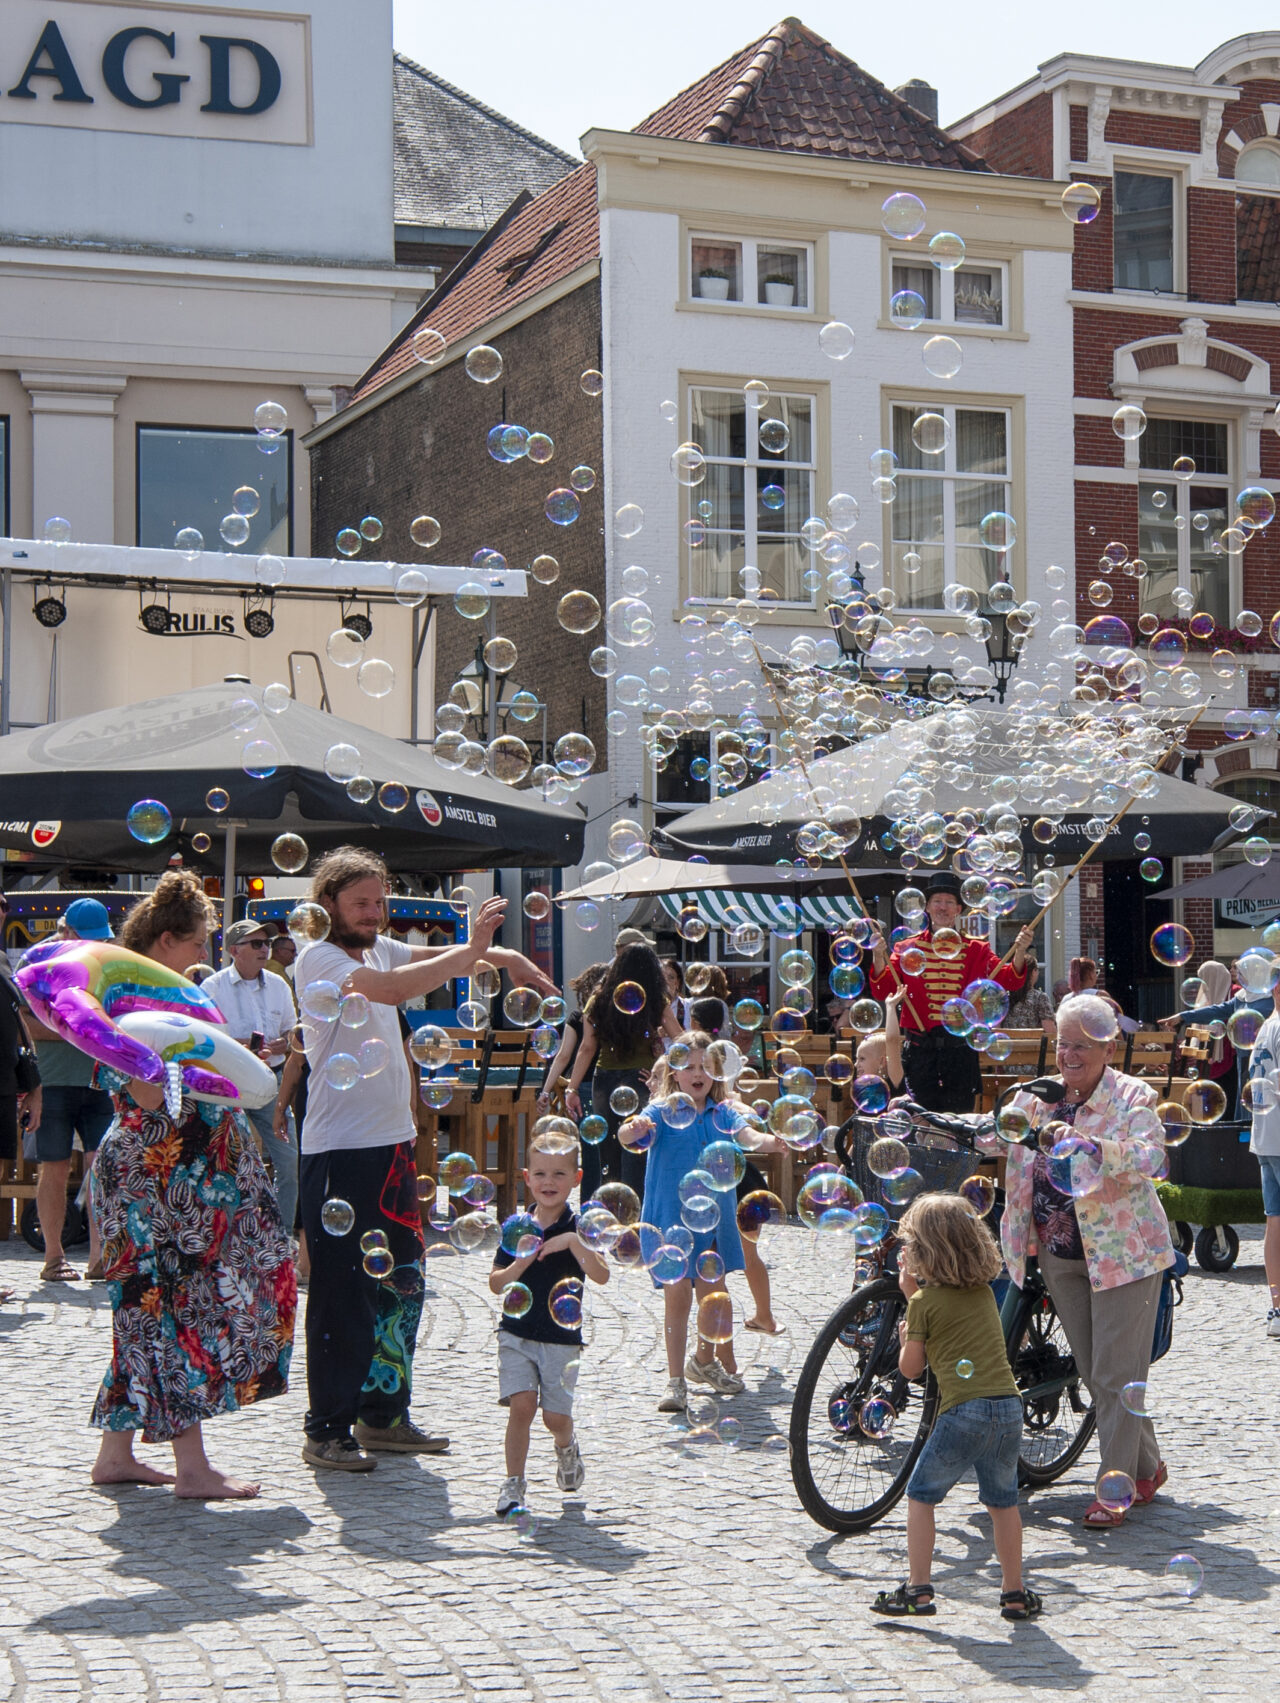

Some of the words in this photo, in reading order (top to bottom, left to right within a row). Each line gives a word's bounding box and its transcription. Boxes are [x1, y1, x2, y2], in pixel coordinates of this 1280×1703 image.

[0, 20, 282, 116] AGD
[166, 612, 235, 632] RULIS
[445, 806, 477, 823] AMSTEL
[477, 811, 496, 828] BIER
[1051, 824, 1091, 836] AMSTEL
[757, 834, 773, 847] BIER
[1226, 898, 1256, 916] PRINS
